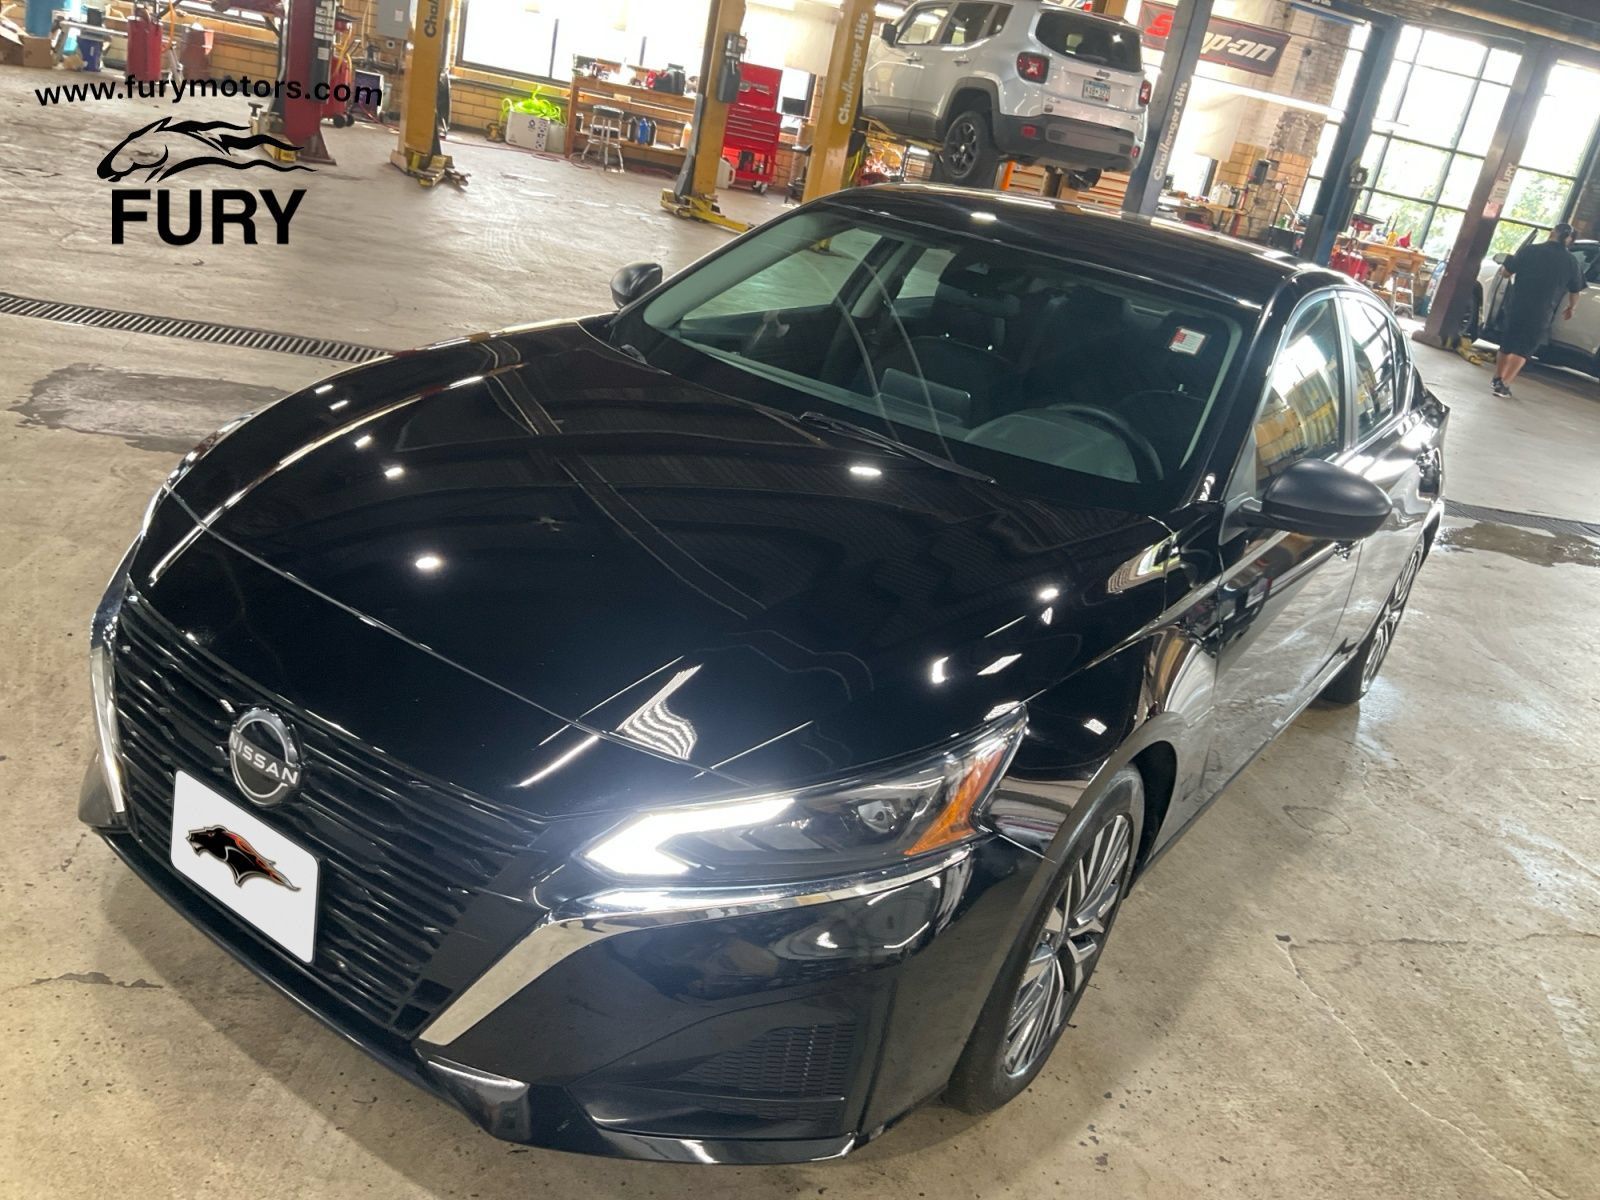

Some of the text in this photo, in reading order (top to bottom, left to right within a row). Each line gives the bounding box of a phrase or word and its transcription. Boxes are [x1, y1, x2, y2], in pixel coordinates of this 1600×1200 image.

[838, 12, 868, 125] Challenger Lifts
[1153, 81, 1188, 180] Challenger Lifts
[229, 731, 299, 784] NISSAN
